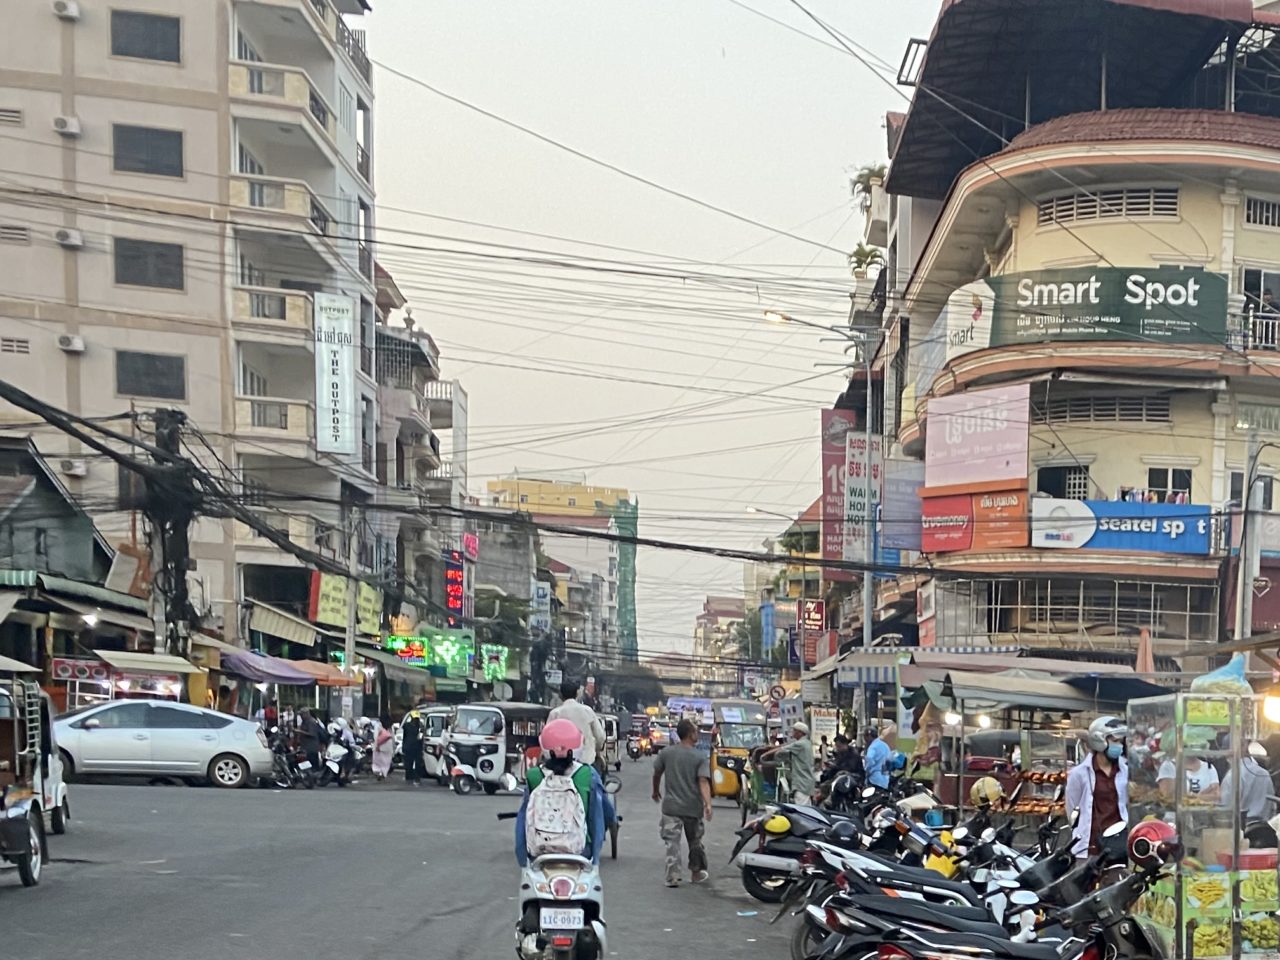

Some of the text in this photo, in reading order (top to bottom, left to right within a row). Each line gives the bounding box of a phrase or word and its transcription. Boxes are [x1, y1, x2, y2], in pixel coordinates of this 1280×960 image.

[1017, 274, 1200, 310] Smart Spot
[331, 350, 339, 376] THE
[331, 382, 341, 442] OUTPOST
[847, 514, 866, 525] HOT
[922, 515, 968, 529] truemoney
[1099, 518, 1157, 532] seatel
